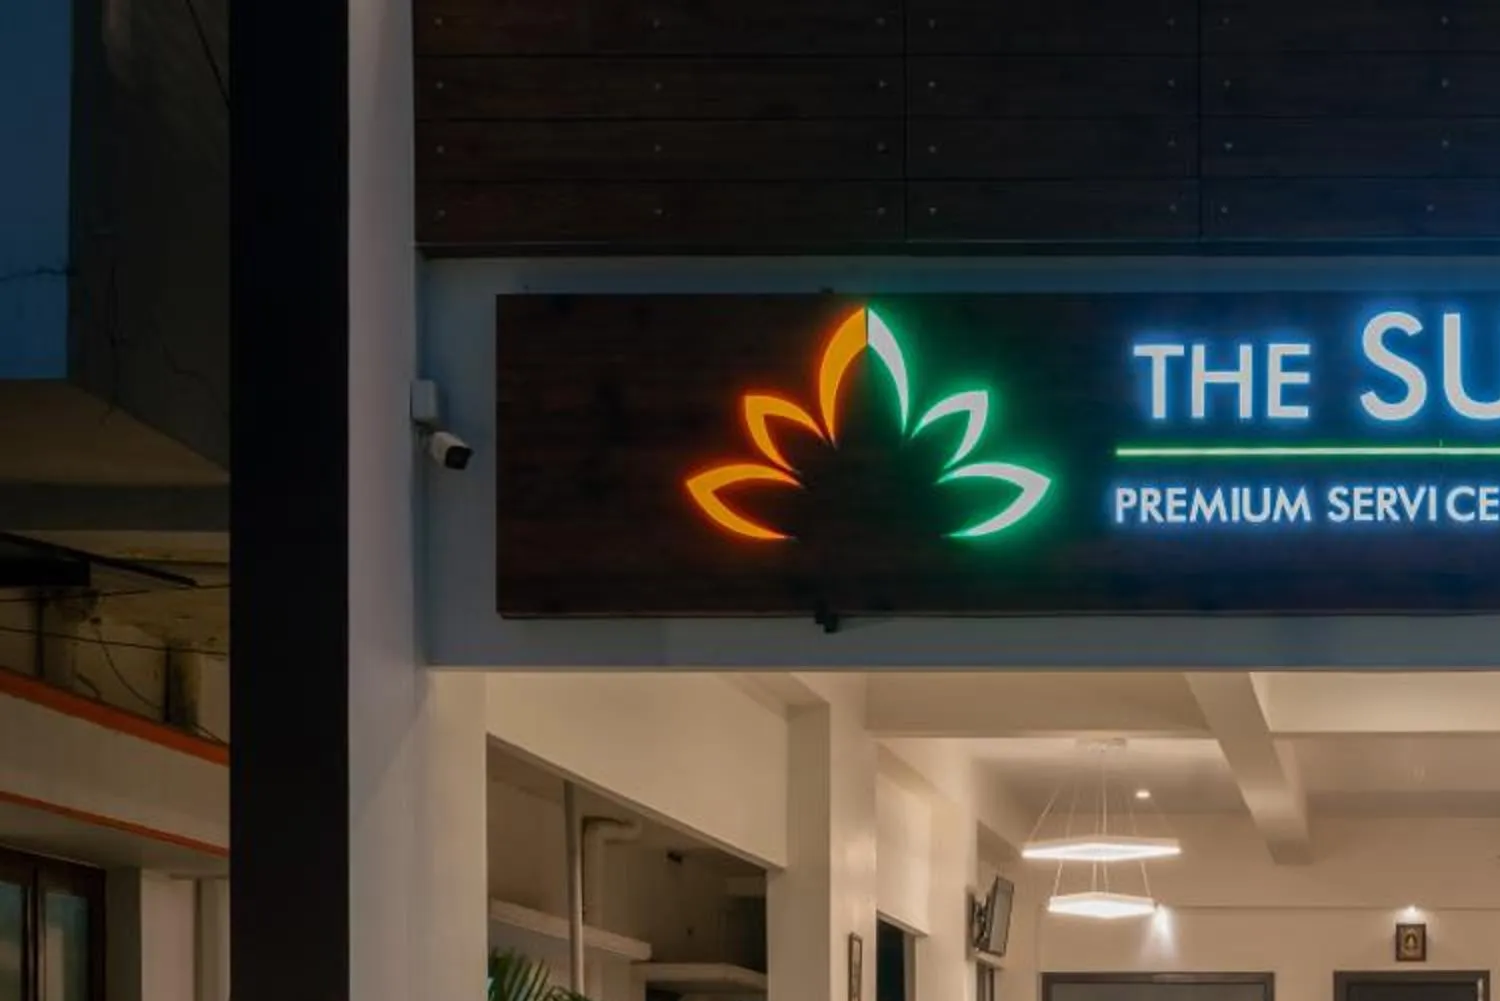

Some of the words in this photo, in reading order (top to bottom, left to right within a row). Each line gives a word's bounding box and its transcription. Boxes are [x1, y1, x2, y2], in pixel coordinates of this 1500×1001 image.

[1133, 343, 1311, 419] THE
[1115, 486, 1312, 524] PREMIUM
[1327, 486, 1499, 522] SERVICE
